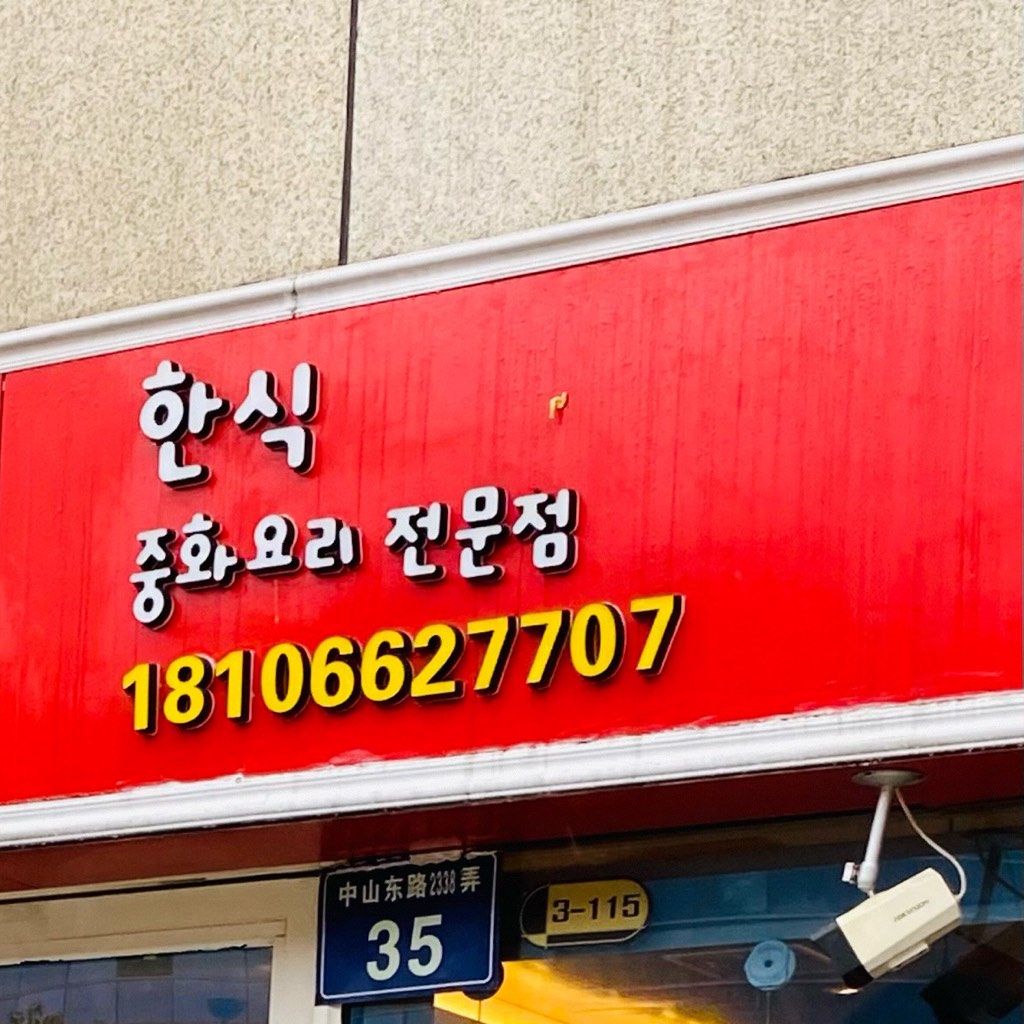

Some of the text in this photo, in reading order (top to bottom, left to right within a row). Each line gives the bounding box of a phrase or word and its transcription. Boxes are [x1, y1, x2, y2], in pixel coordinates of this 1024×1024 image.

[139, 359, 319, 487] 한식
[129, 486, 579, 630] 중화요리 전문점
[122, 594, 686, 735] 18106627707
[365, 913, 444, 982] 35
[551, 893, 642, 924] 3-115
